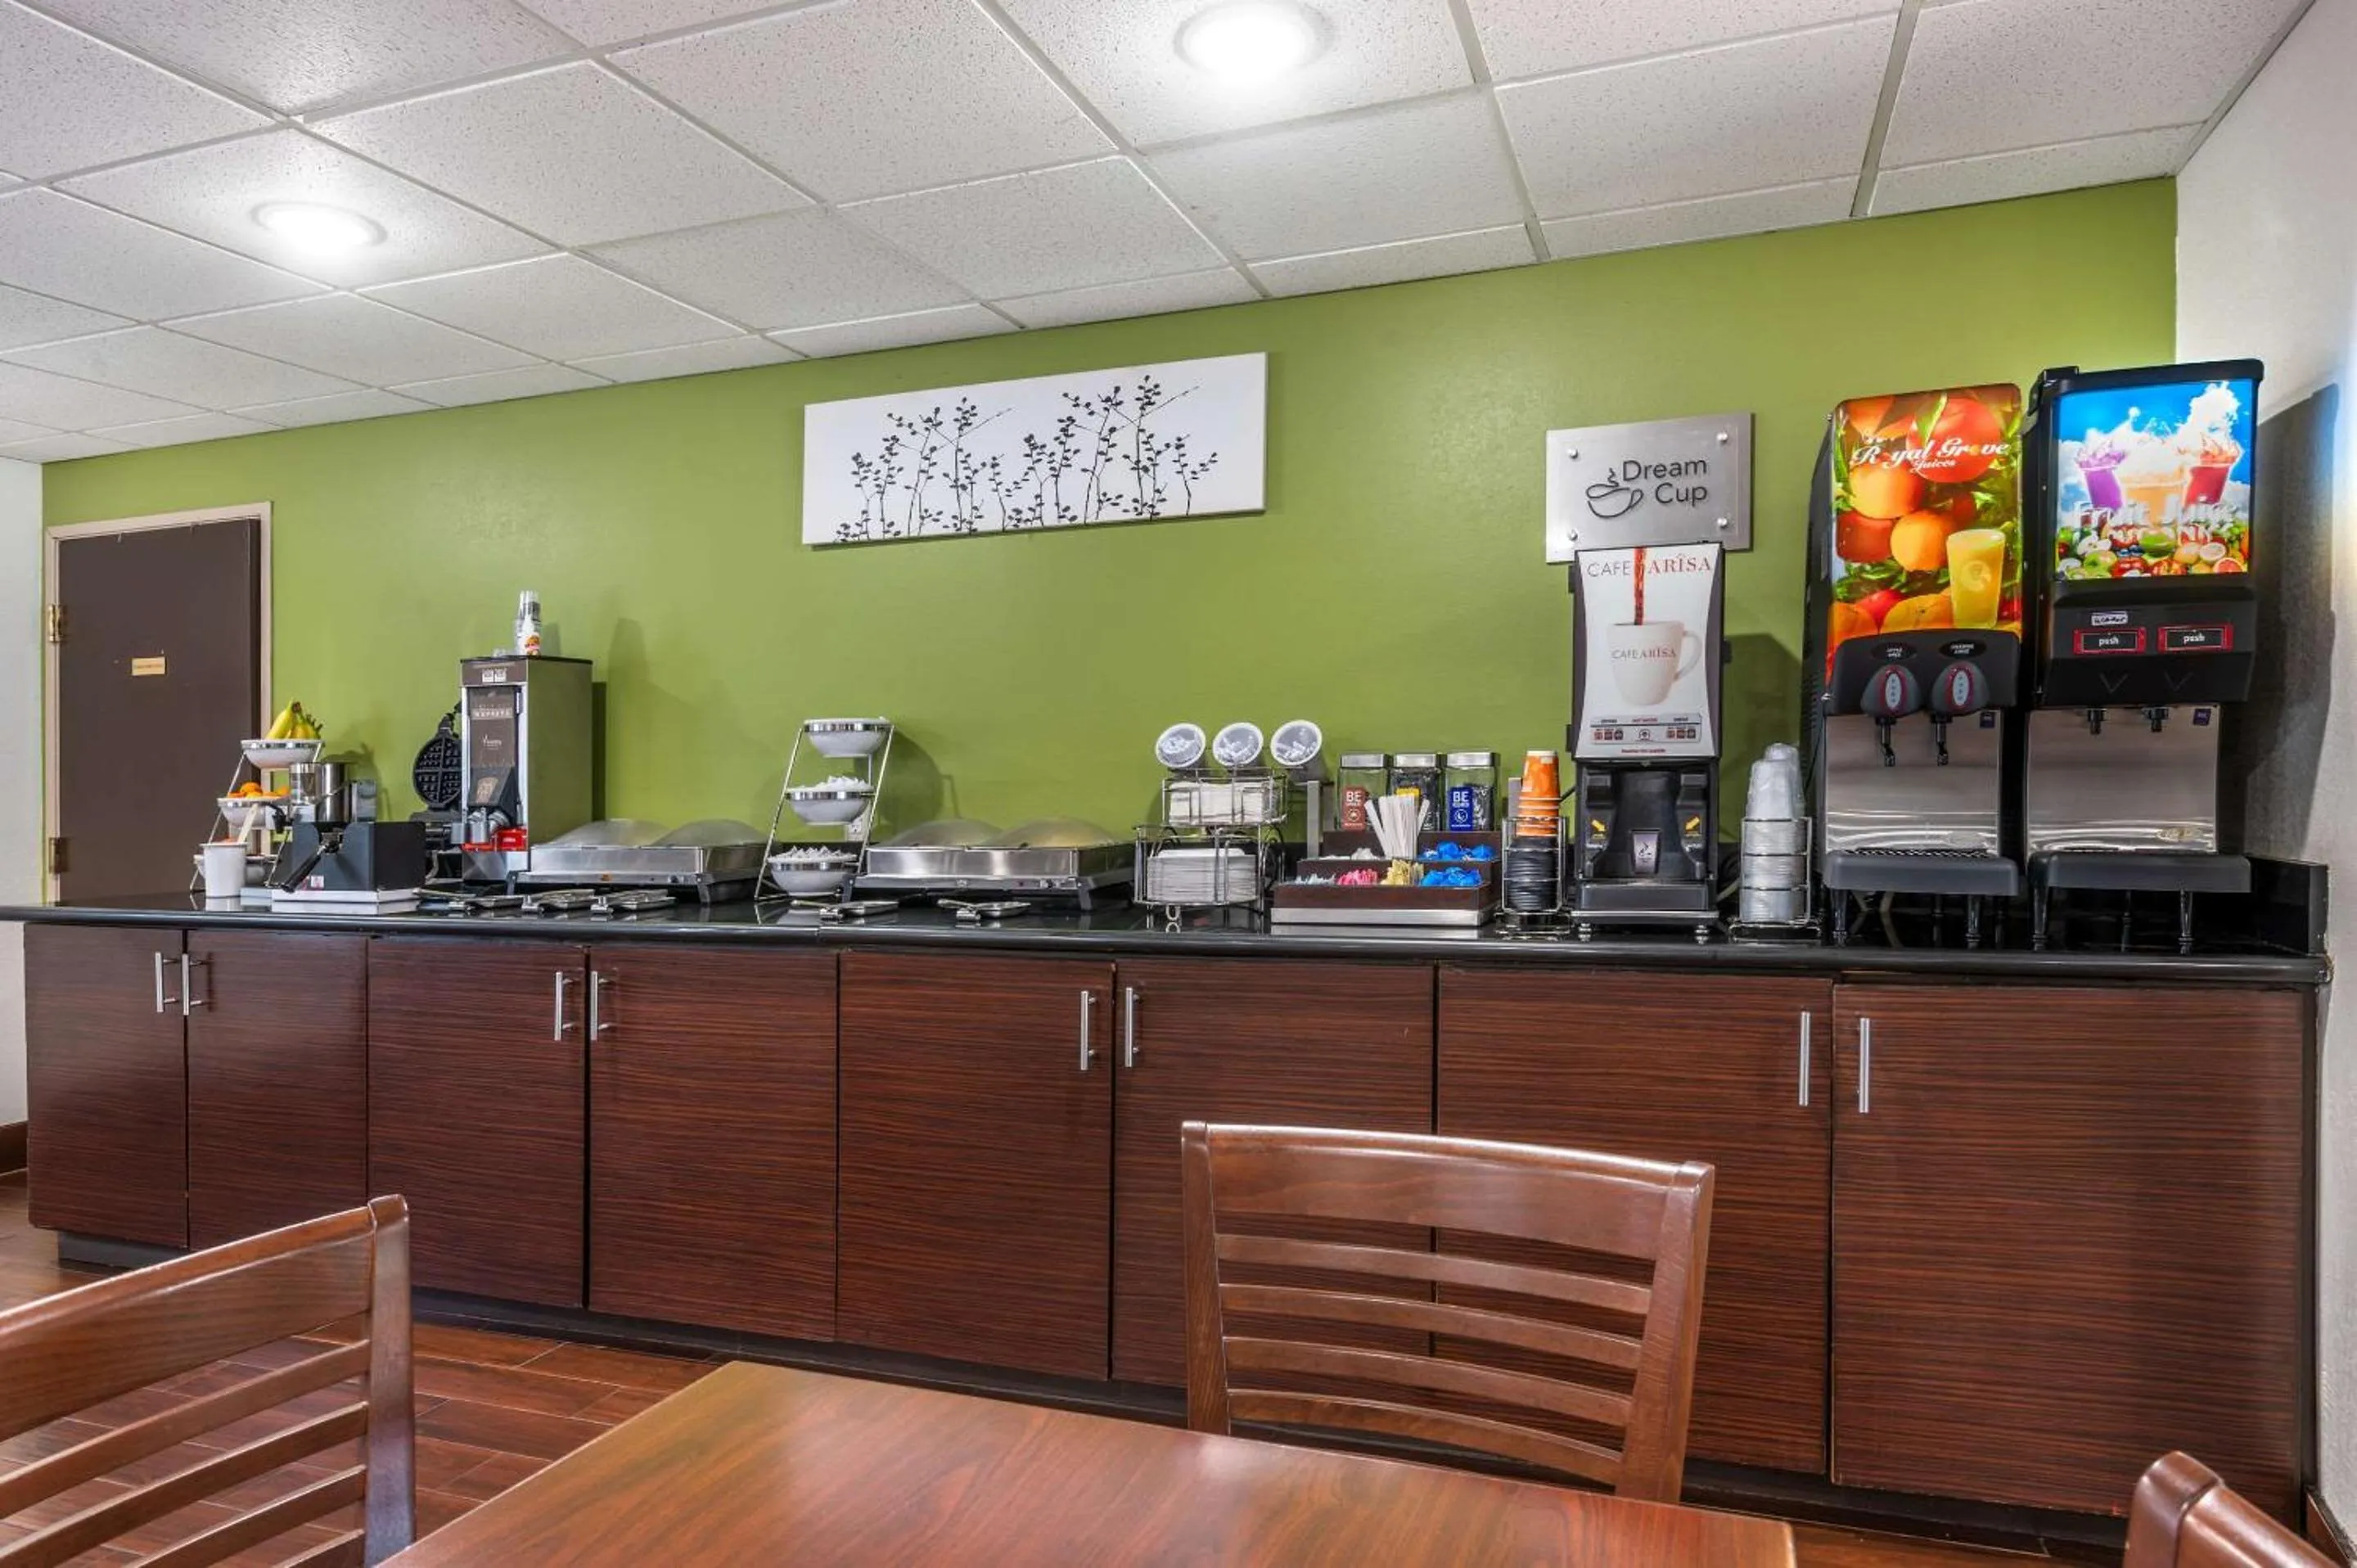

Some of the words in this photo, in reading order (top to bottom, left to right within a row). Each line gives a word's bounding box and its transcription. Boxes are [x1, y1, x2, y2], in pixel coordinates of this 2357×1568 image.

[1850, 439, 1936, 469] Royal
[1936, 437, 2011, 457] Grove
[1622, 458, 1707, 481] Dream
[1655, 482, 1707, 507] Cup
[1587, 560, 1631, 578] CAFE
[2098, 635, 2120, 647] push
[1345, 791, 1362, 803] BE
[1453, 791, 1470, 803] BE
